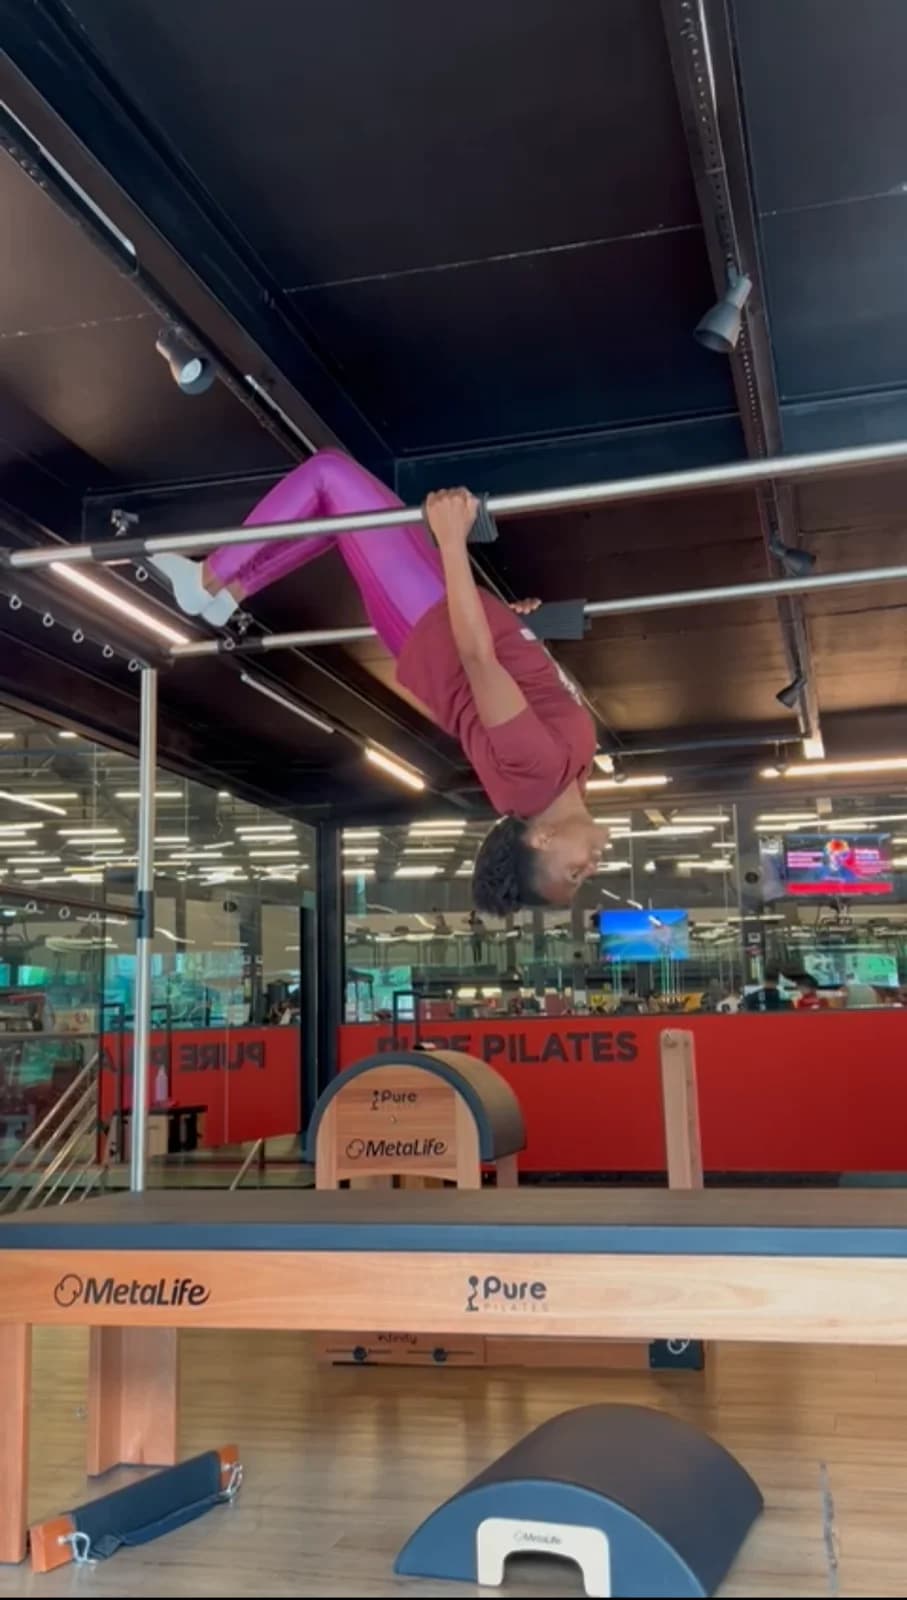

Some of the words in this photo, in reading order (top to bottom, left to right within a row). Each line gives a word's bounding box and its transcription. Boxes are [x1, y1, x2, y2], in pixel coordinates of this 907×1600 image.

[482, 1031, 639, 1064] PILATES
[381, 1089, 417, 1103] Pure
[366, 1138, 449, 1158] MetaLife
[83, 1277, 212, 1306] MetaLife
[483, 1275, 548, 1300] Pure
